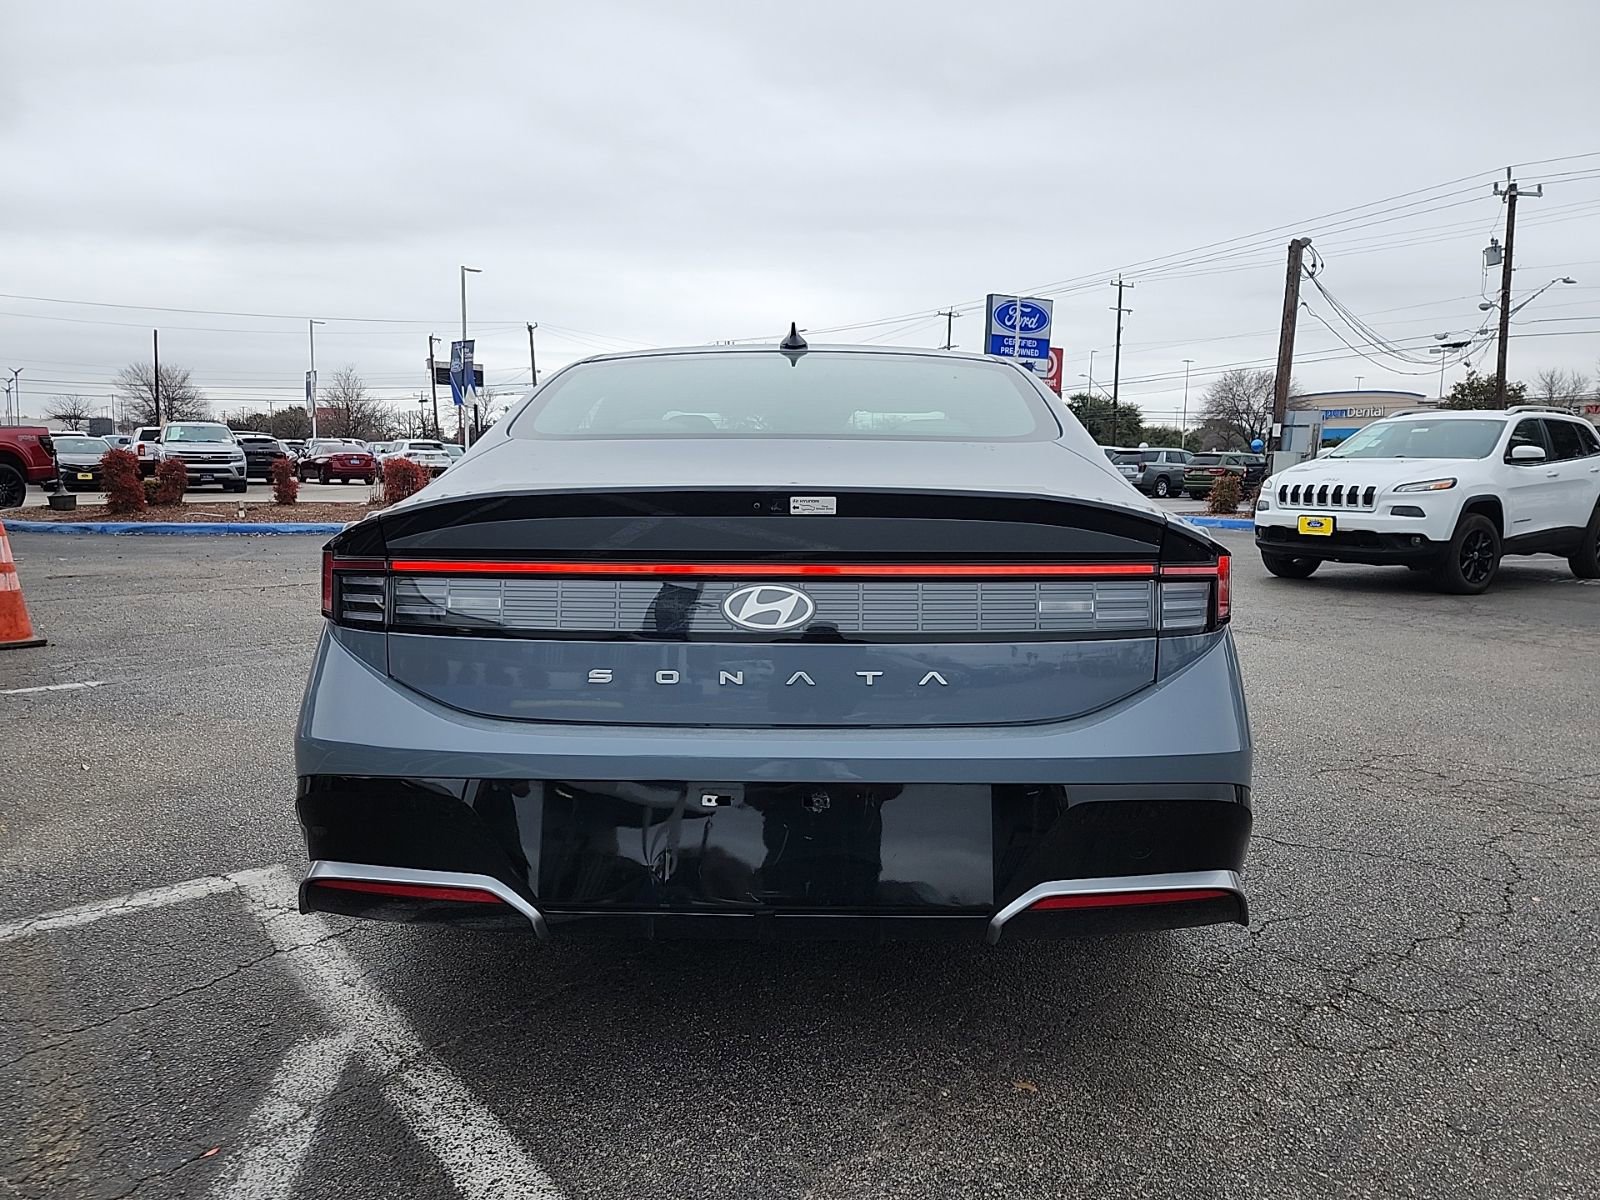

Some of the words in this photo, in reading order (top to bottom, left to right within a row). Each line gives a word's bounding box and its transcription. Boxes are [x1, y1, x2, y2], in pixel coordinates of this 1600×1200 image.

[1003, 337, 1038, 348] CERIFIED
[1042, 378, 1057, 387] rget
[588, 669, 949, 686] SONATA
